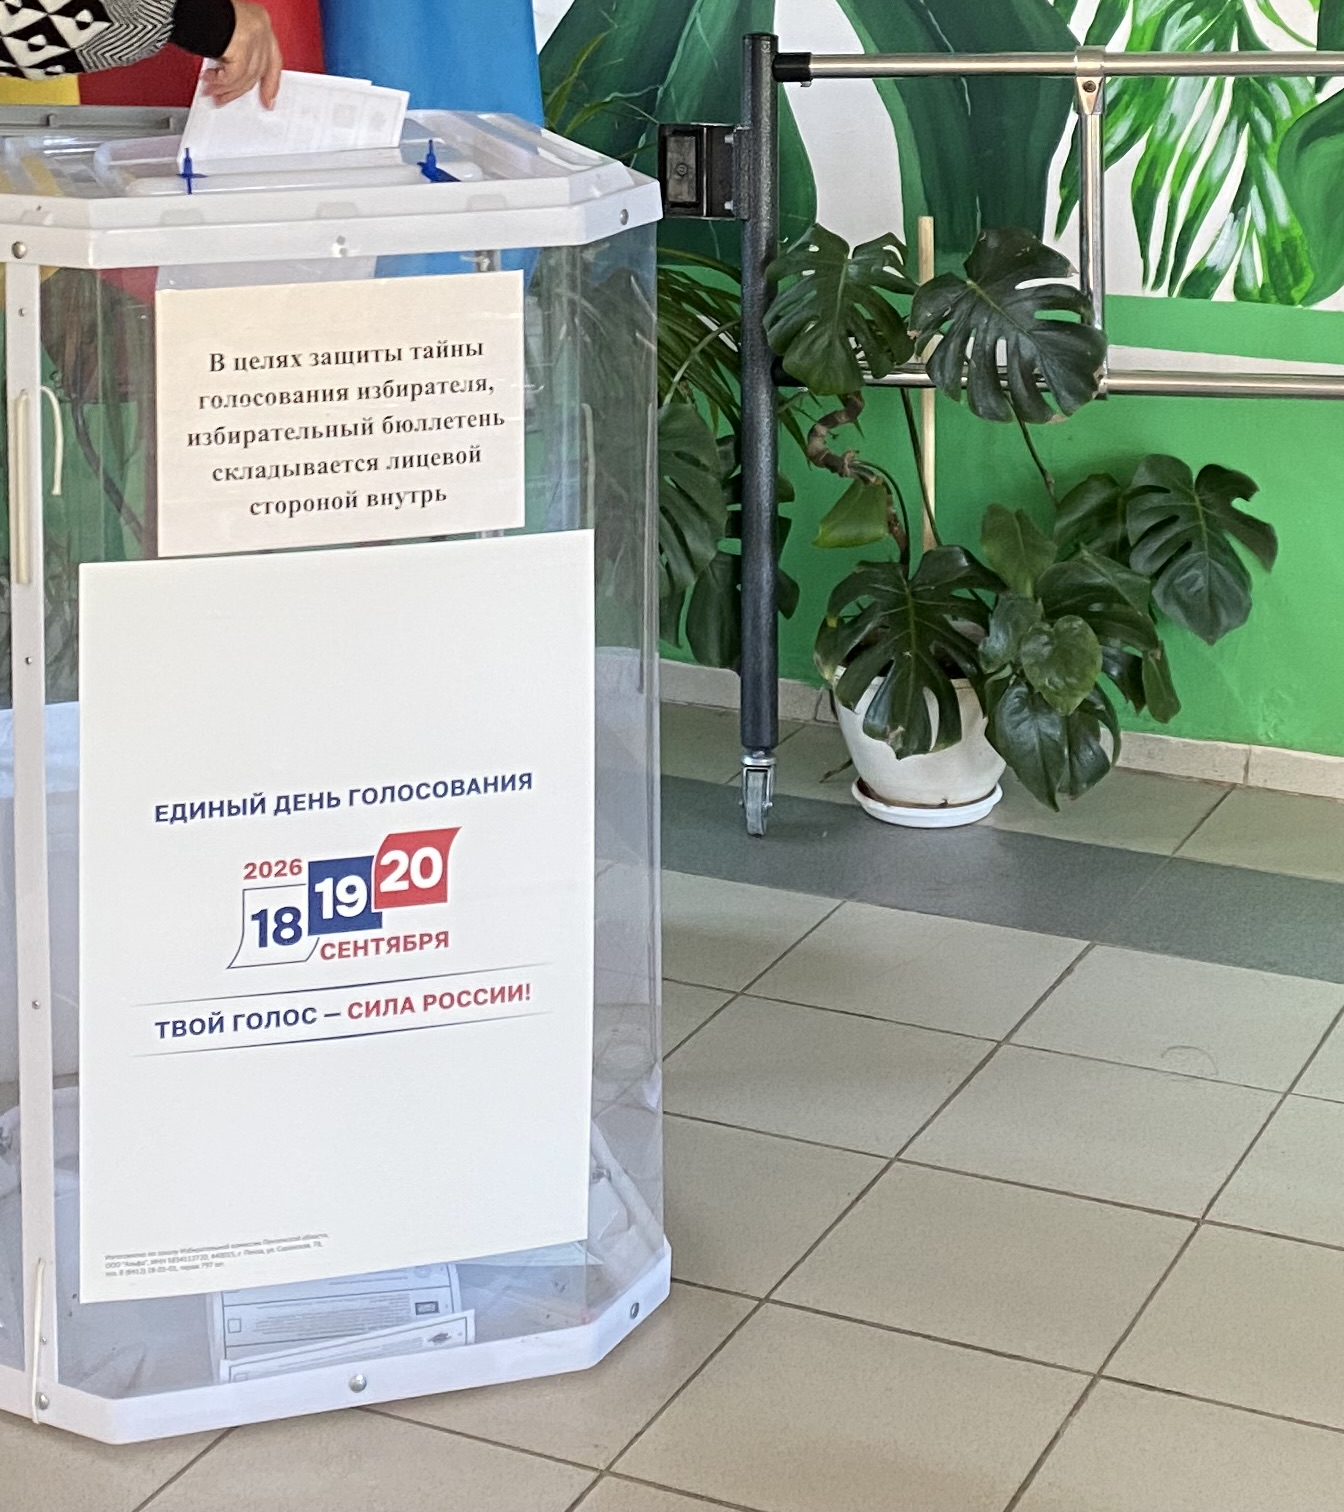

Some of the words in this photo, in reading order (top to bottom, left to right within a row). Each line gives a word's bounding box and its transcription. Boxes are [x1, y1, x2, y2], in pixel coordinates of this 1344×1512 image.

[208, 352, 225, 372] В
[234, 352, 302, 374] целях
[308, 346, 403, 368] защиты
[410, 339, 484, 361] тайны
[198, 387, 349, 410] голосования
[356, 378, 494, 403] избирателя,
[187, 417, 374, 449] избирательный
[382, 412, 506, 436] бюллетень
[211, 457, 379, 484] складывается
[385, 445, 482, 471] лицевой
[249, 490, 358, 519] стороной
[366, 487, 447, 511] внутрь
[154, 793, 267, 825] ЕДИНЫЙ
[273, 791, 342, 816] ДЕНЬ
[349, 772, 534, 808] ГОЛОСОВАНИЯ
[243, 858, 303, 881] 2026
[250, 905, 303, 949] 18
[314, 874, 368, 919] 19
[379, 846, 443, 894] 20
[319, 930, 450, 961] СЕНТЯБРЯ
[154, 1011, 226, 1040] ТВОЙ
[233, 1006, 318, 1032] ГОЛОС
[347, 996, 416, 1022] СИЛА
[423, 983, 533, 1012] РОССИИ!
